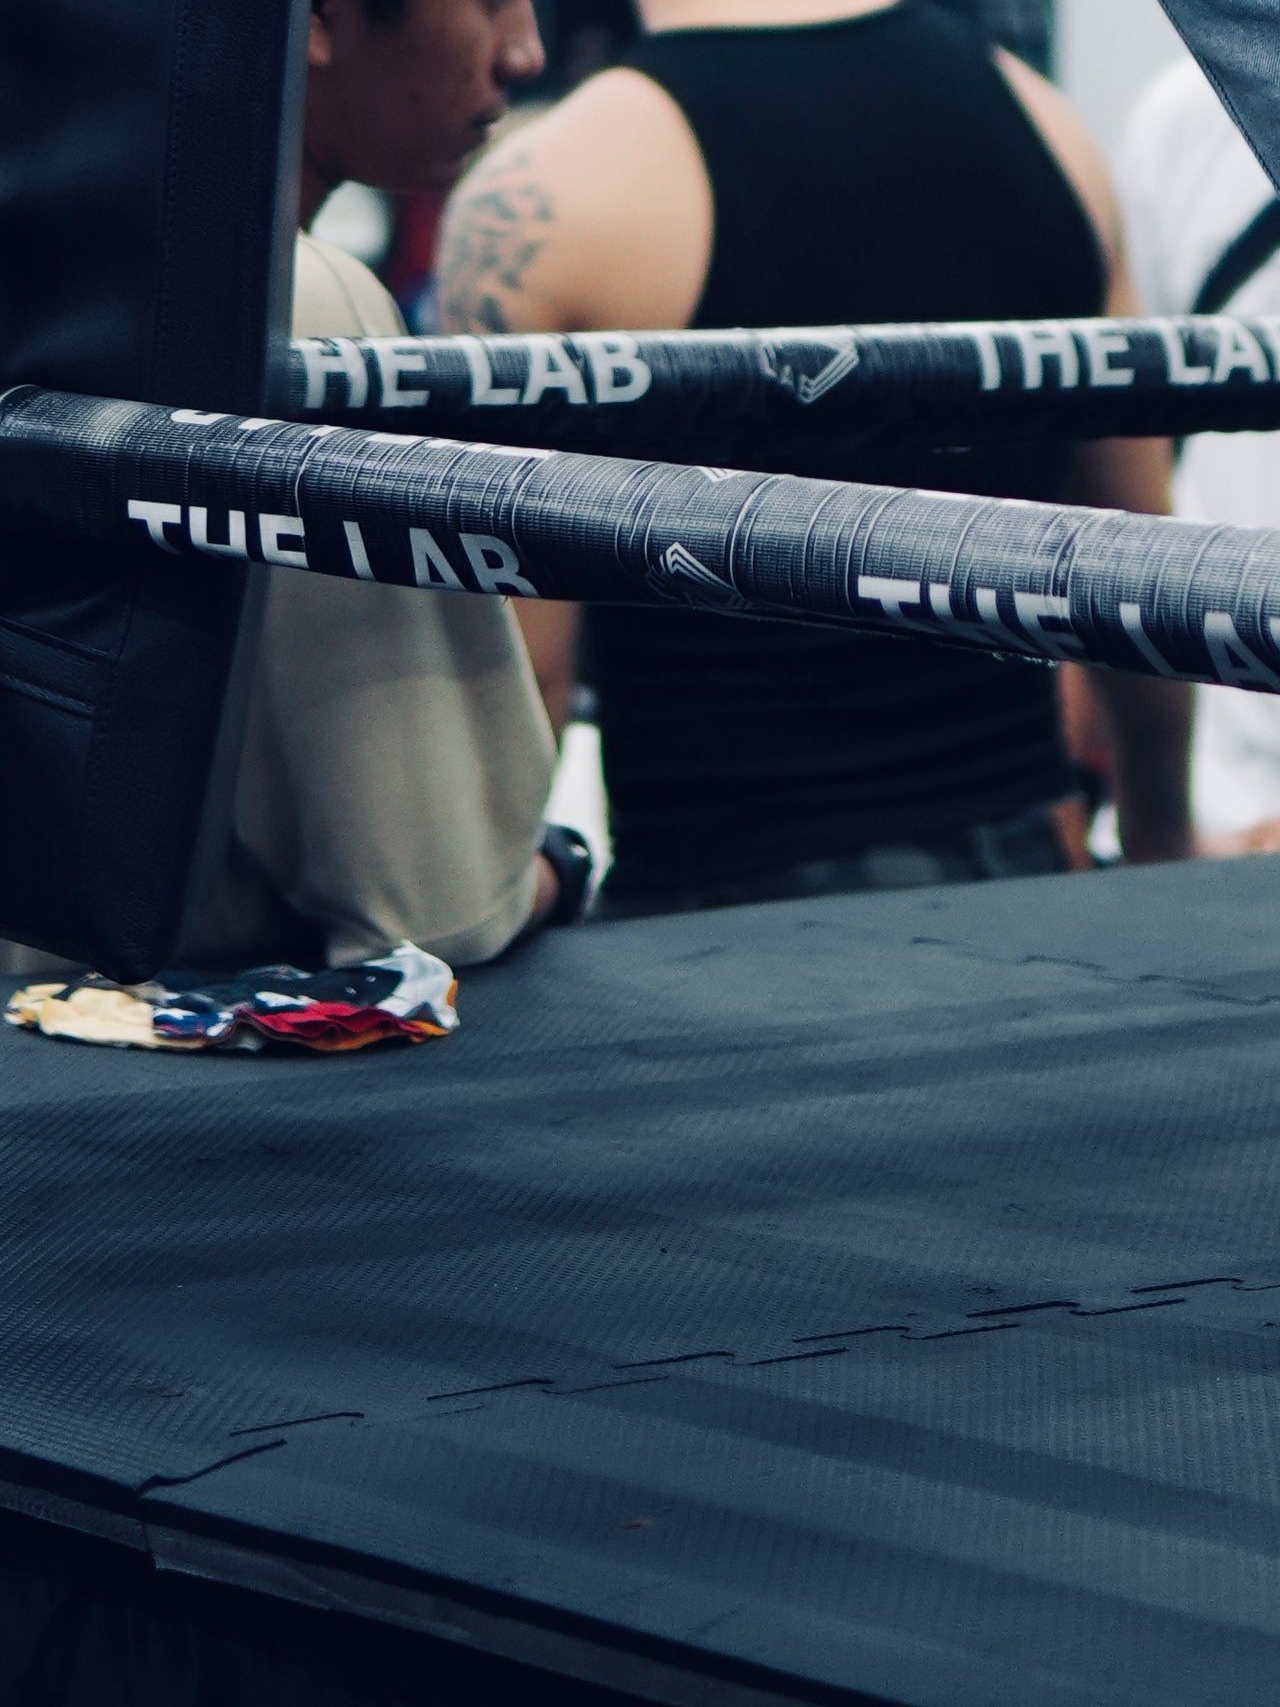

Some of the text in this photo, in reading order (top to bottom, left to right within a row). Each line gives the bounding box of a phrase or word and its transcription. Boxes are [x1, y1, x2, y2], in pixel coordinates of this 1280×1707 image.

[289, 332, 652, 409] HE LAB
[963, 321, 1136, 391] THE
